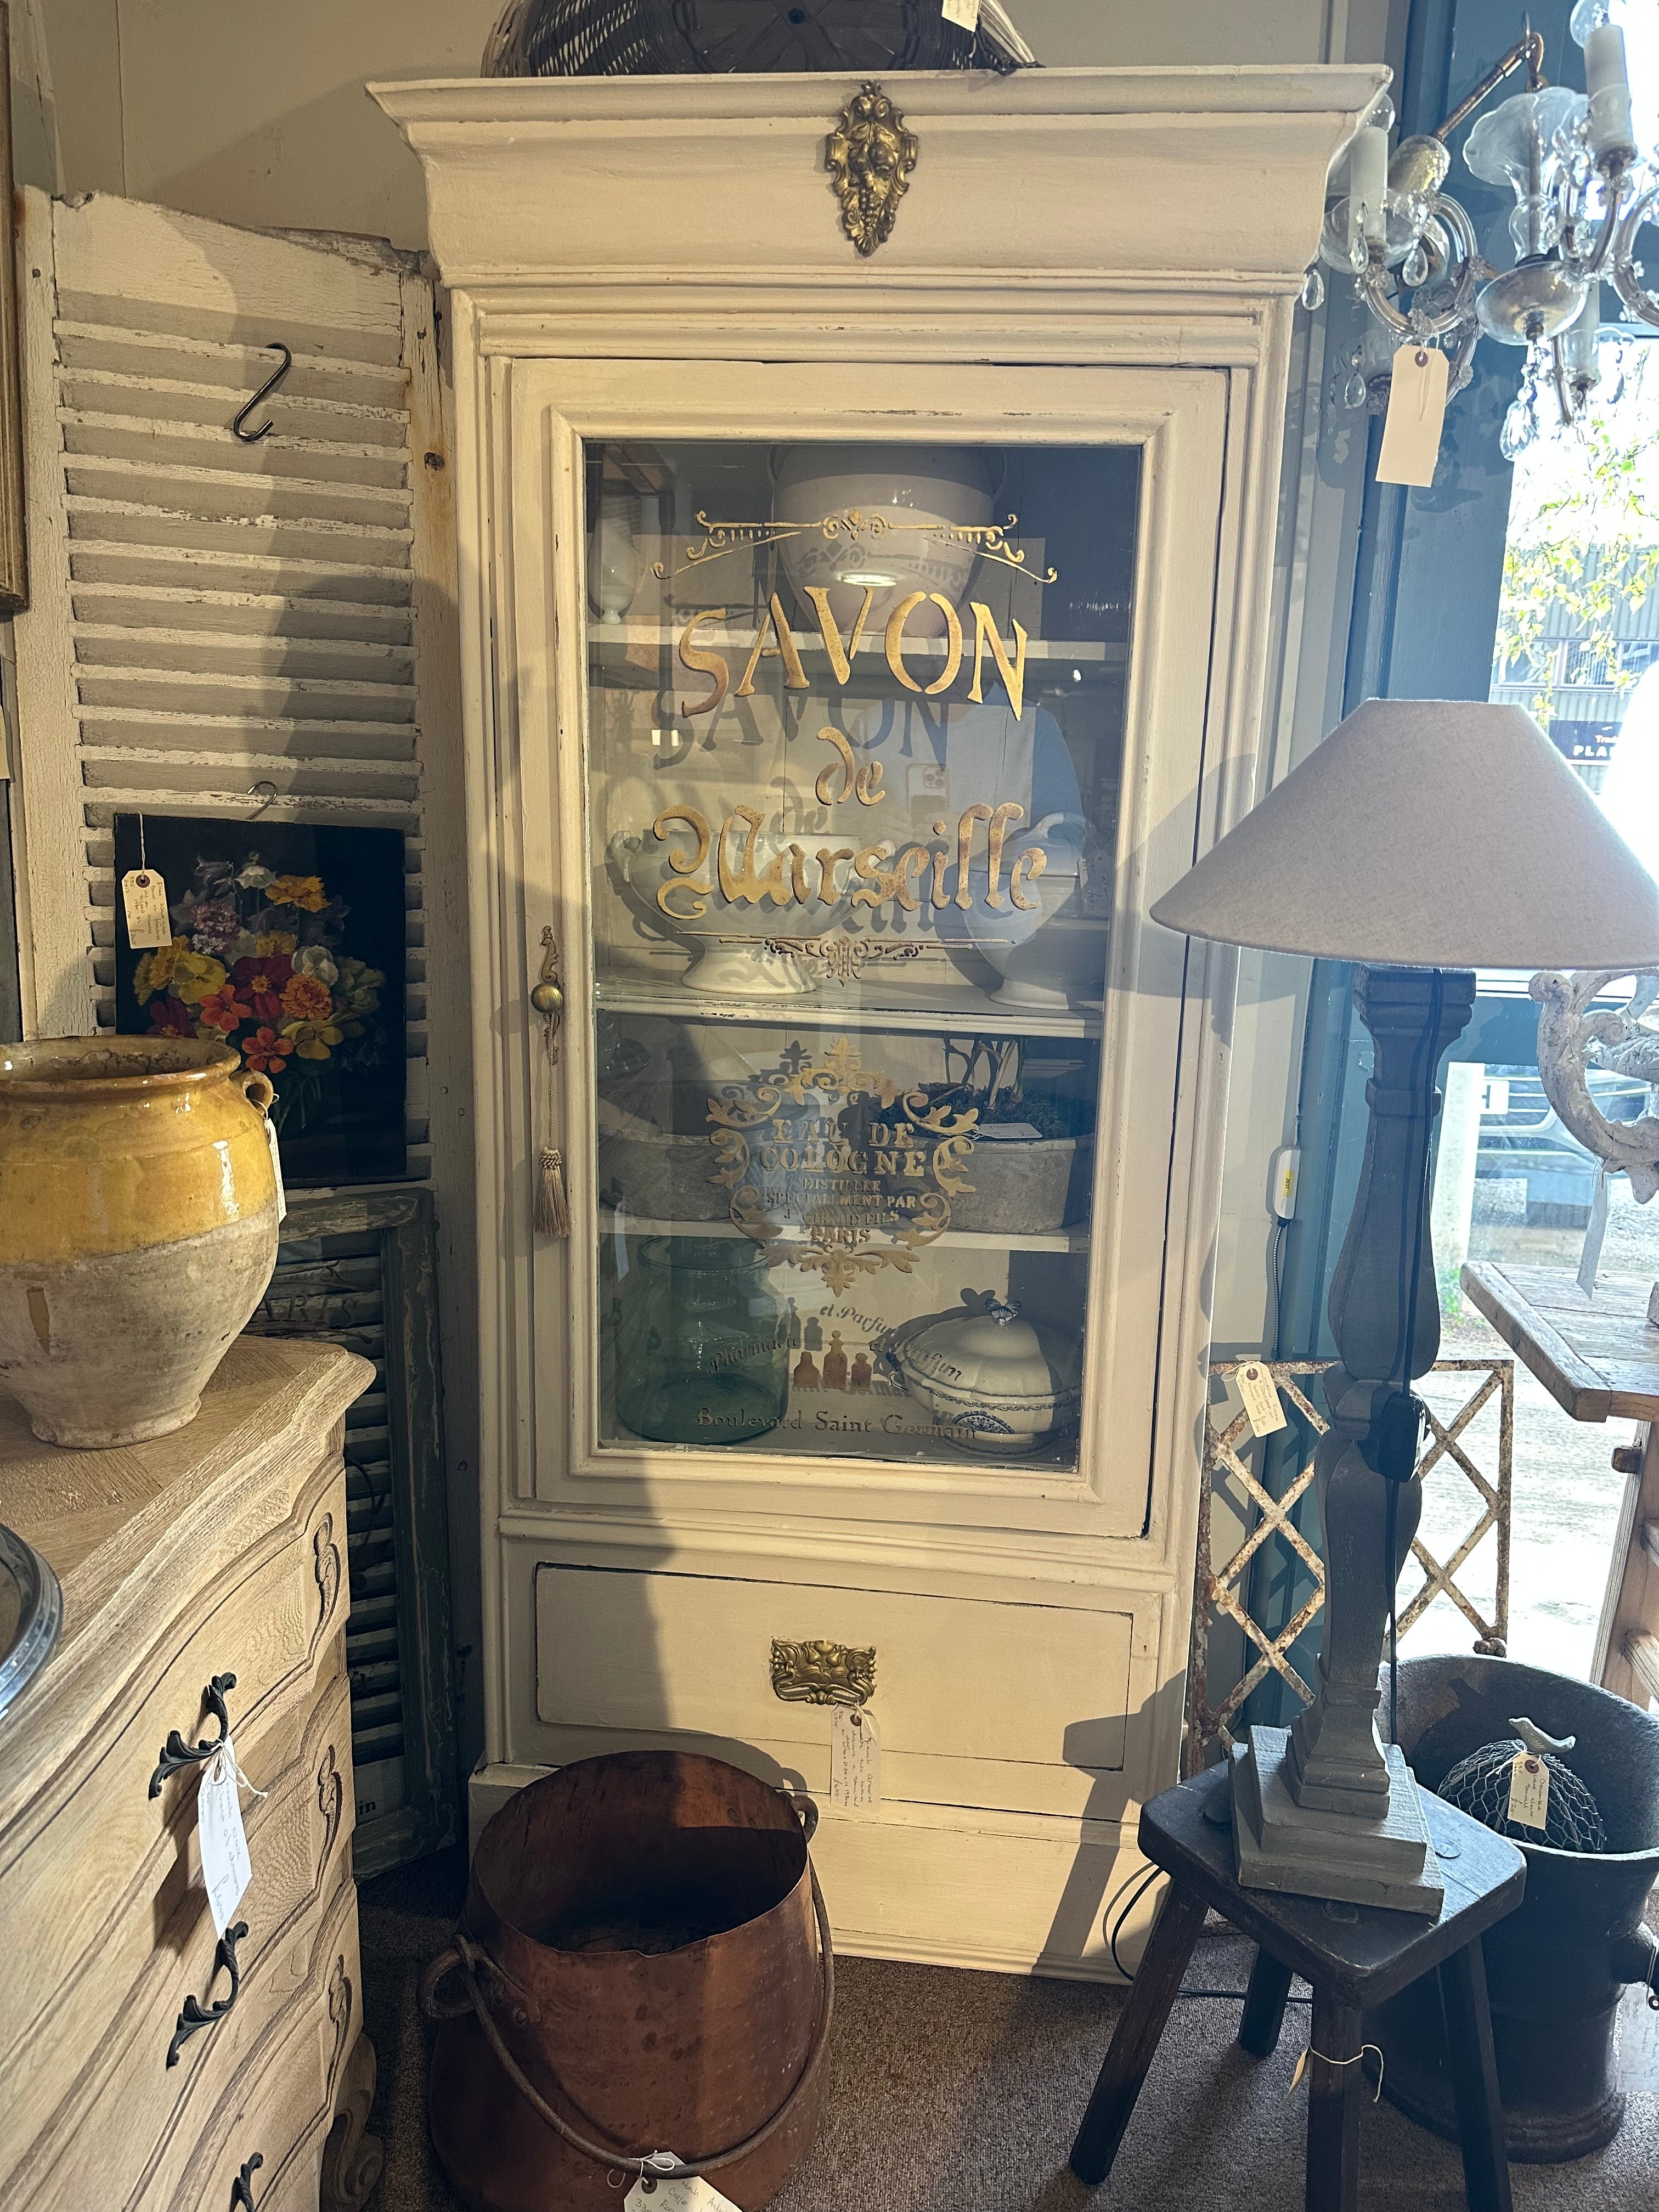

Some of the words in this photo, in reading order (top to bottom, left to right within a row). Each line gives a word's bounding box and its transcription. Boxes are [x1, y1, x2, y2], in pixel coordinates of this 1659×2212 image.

[679, 586, 1028, 721] SAVON
[816, 726, 885, 805] de
[653, 803, 1048, 919] Marseille
[772, 1119, 848, 1146] EAU
[868, 1122, 914, 1148] DE
[760, 1146, 927, 1177] COLOGNE
[887, 1195, 916, 1208] PAR
[810, 1226, 871, 1244] PARIS
[697, 1406, 803, 1429] Boulevard
[815, 1410, 872, 1432] Saint
[881, 1414, 977, 1440] Germain
